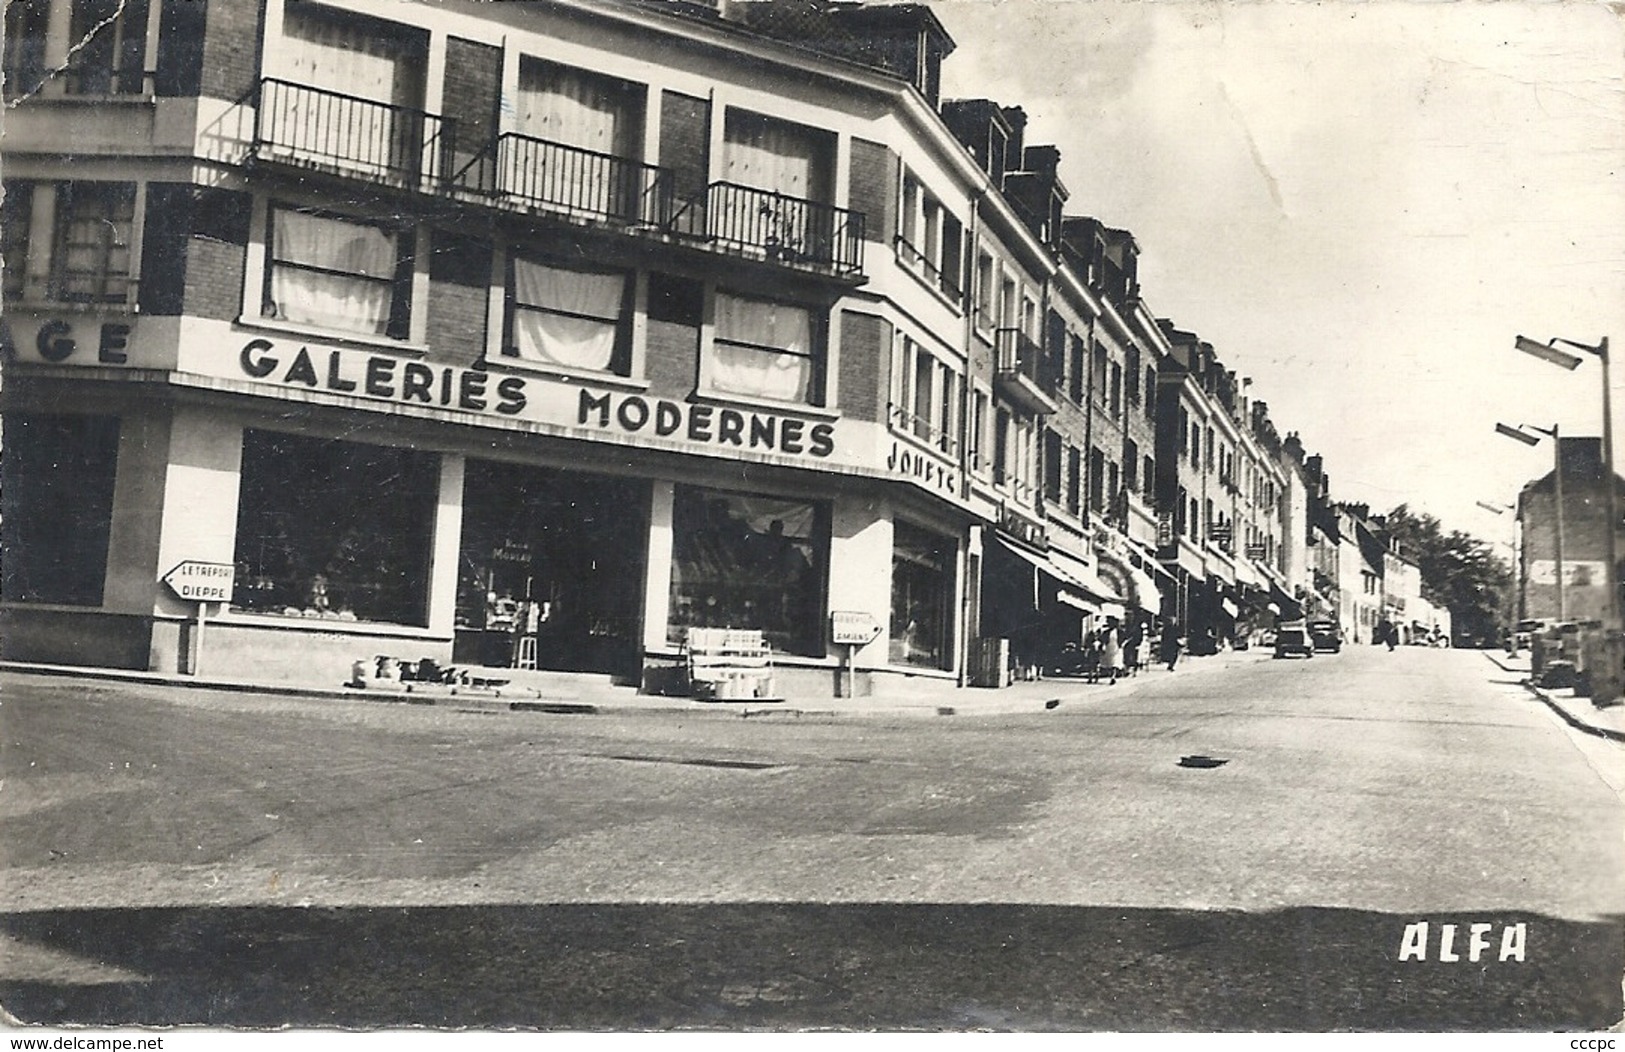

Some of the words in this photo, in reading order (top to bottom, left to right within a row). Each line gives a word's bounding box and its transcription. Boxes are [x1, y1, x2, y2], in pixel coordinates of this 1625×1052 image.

[240, 338, 527, 415] GALERIES
[577, 387, 836, 458] MODERNES
[182, 584, 225, 599] DIEPPE
